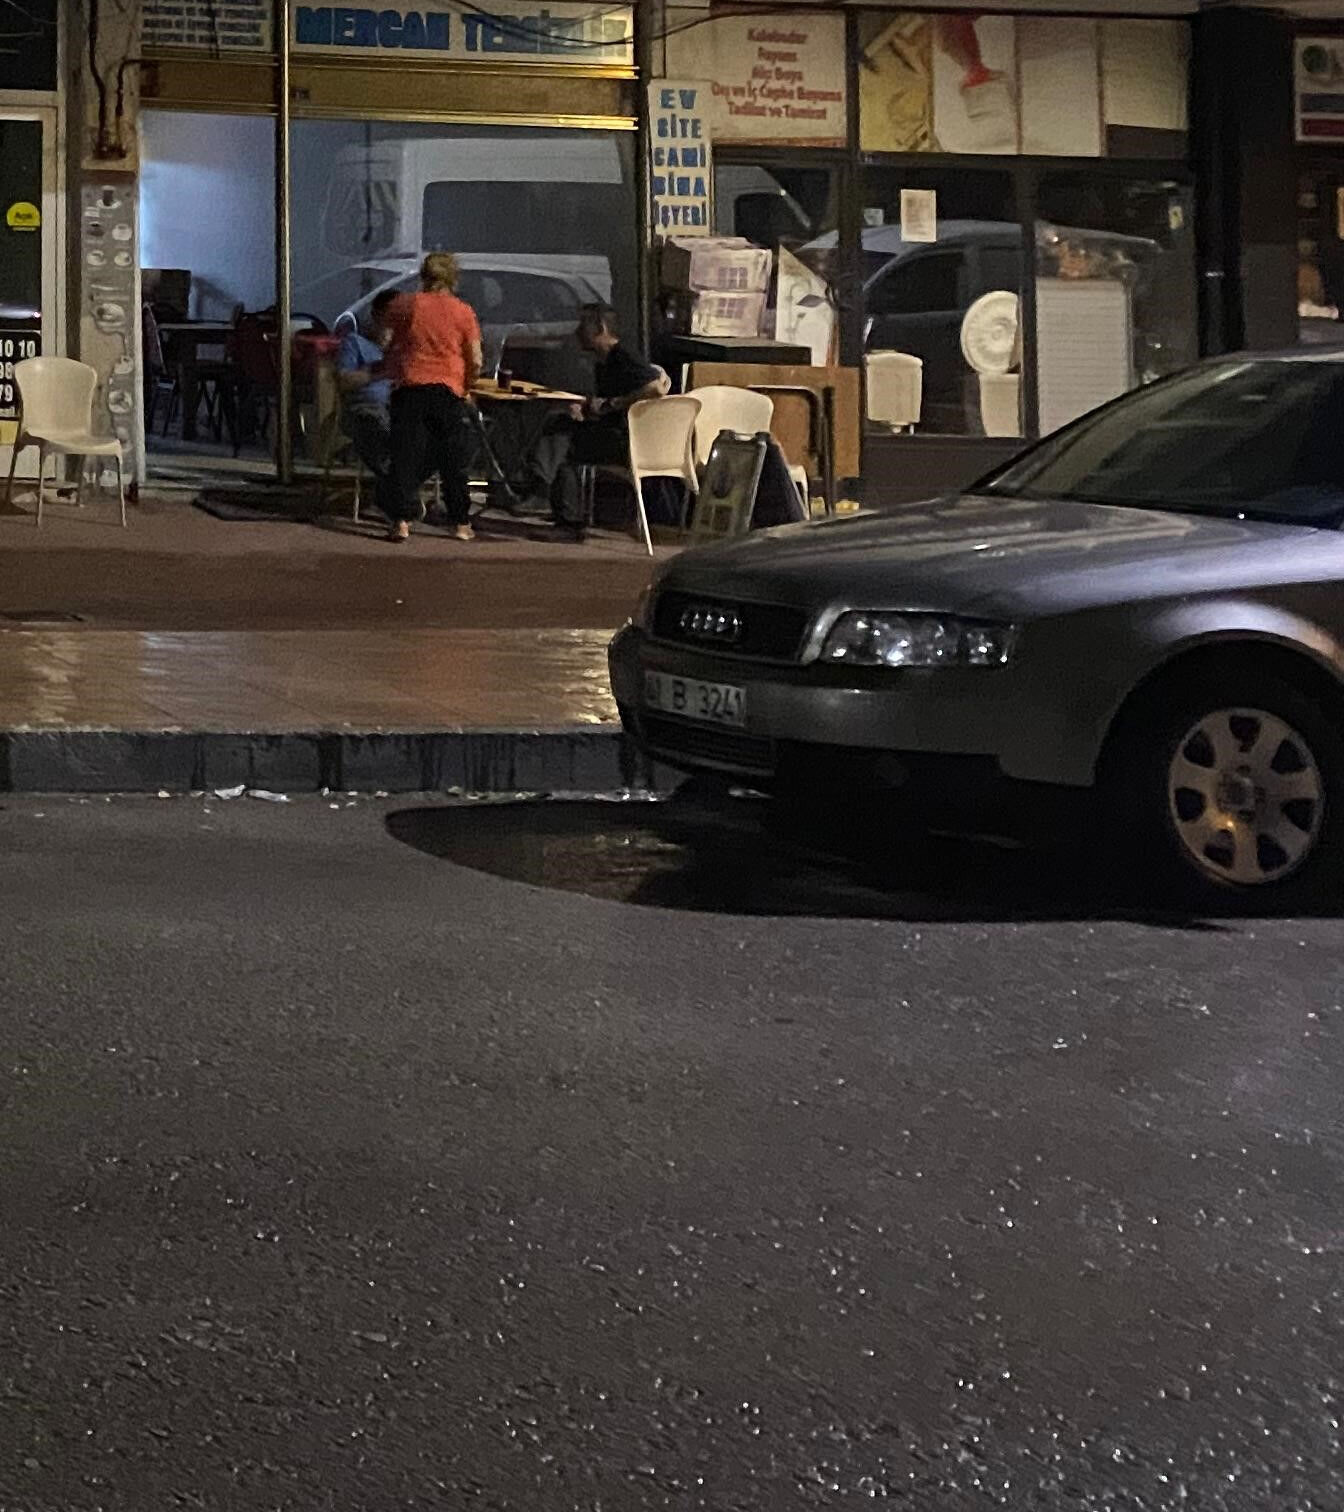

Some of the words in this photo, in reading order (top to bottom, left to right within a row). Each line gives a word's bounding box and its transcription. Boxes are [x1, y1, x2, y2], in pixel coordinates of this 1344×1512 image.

[660, 89, 697, 110] EV
[657, 114, 703, 139] SİTE
[654, 143, 707, 168] CAMİ
[18, 339, 36, 358] 10
[673, 679, 687, 710] B
